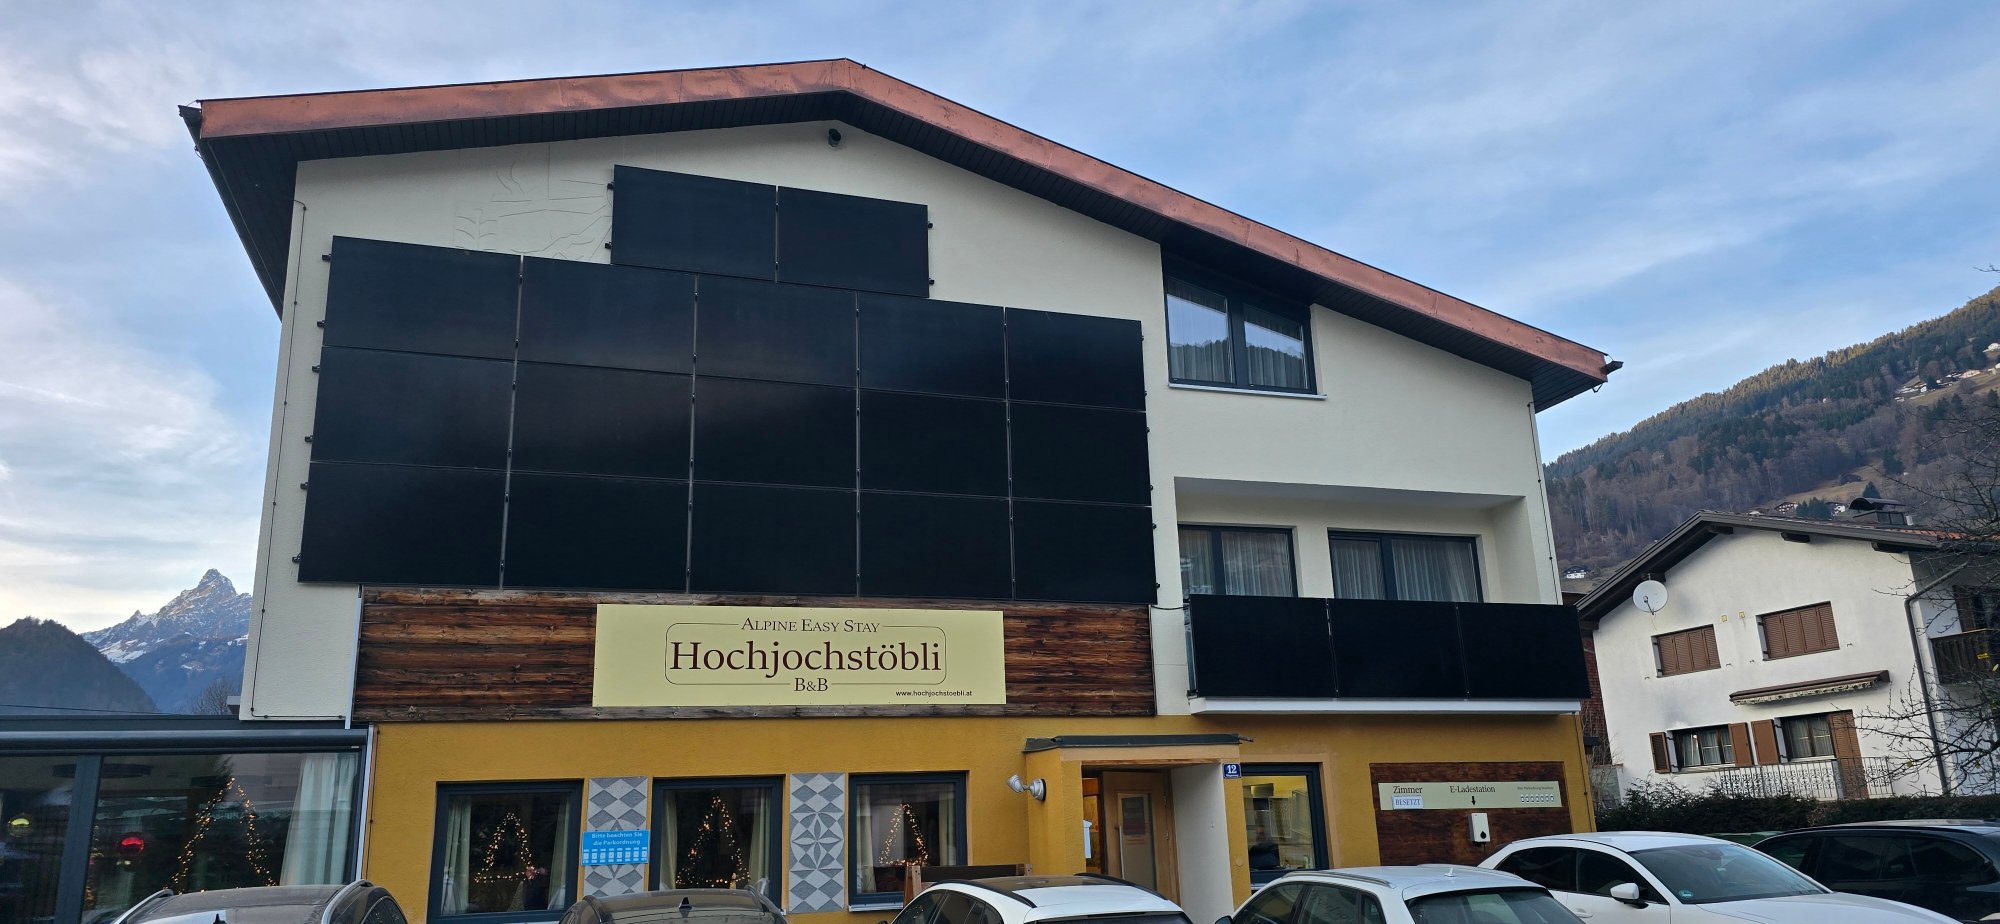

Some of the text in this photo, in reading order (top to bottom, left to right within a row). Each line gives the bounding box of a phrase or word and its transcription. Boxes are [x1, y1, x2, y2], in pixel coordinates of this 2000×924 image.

[741, 617, 880, 632] ALPINE EASY STAY
[669, 640, 942, 678] Hochjochstöbli
[794, 677, 828, 692] B&B
[895, 690, 972, 698] www.hochjochstoebli.at
[1227, 765, 1237, 774] 12
[1392, 785, 1423, 794] Zimmer
[1449, 785, 1496, 793] E-Ladestation
[1395, 798, 1421, 806] BESETZT
